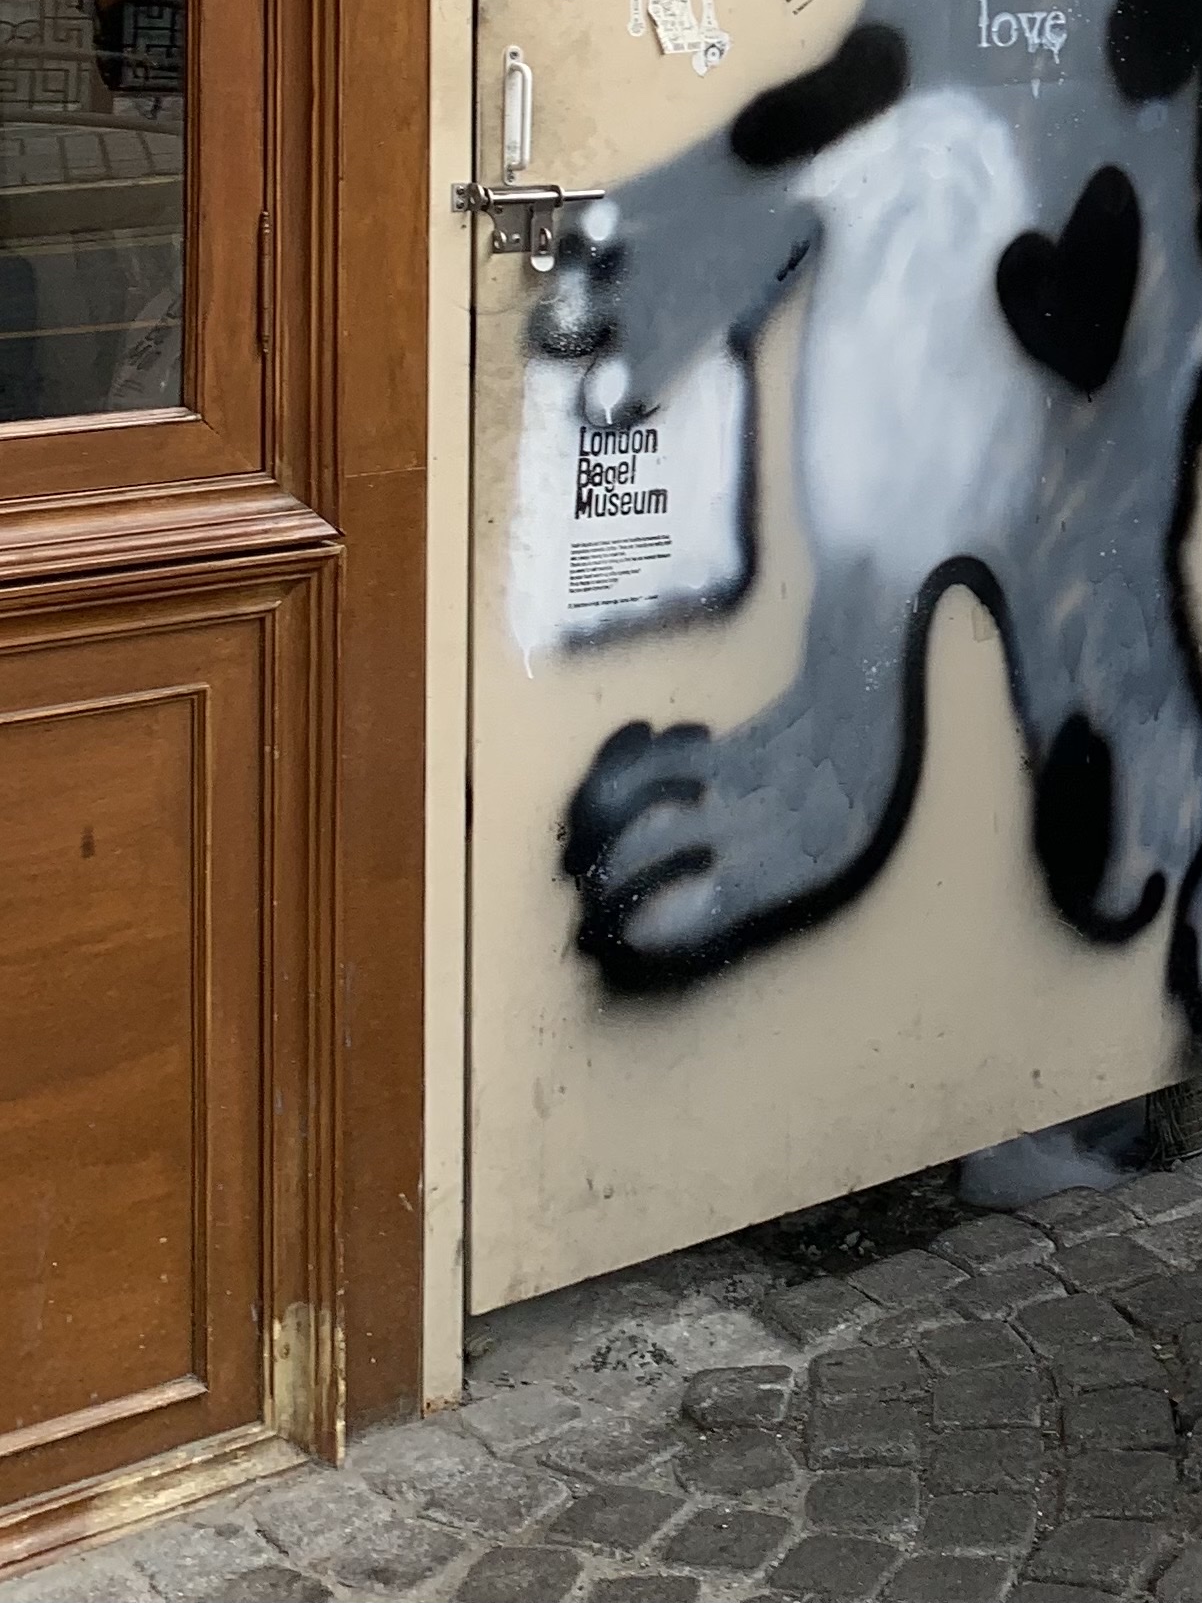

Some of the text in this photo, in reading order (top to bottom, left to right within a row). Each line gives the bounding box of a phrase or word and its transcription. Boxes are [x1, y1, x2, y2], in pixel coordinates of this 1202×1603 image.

[578, 425, 659, 457] London
[577, 454, 637, 494] Bagel
[574, 487, 668, 520] Museum
